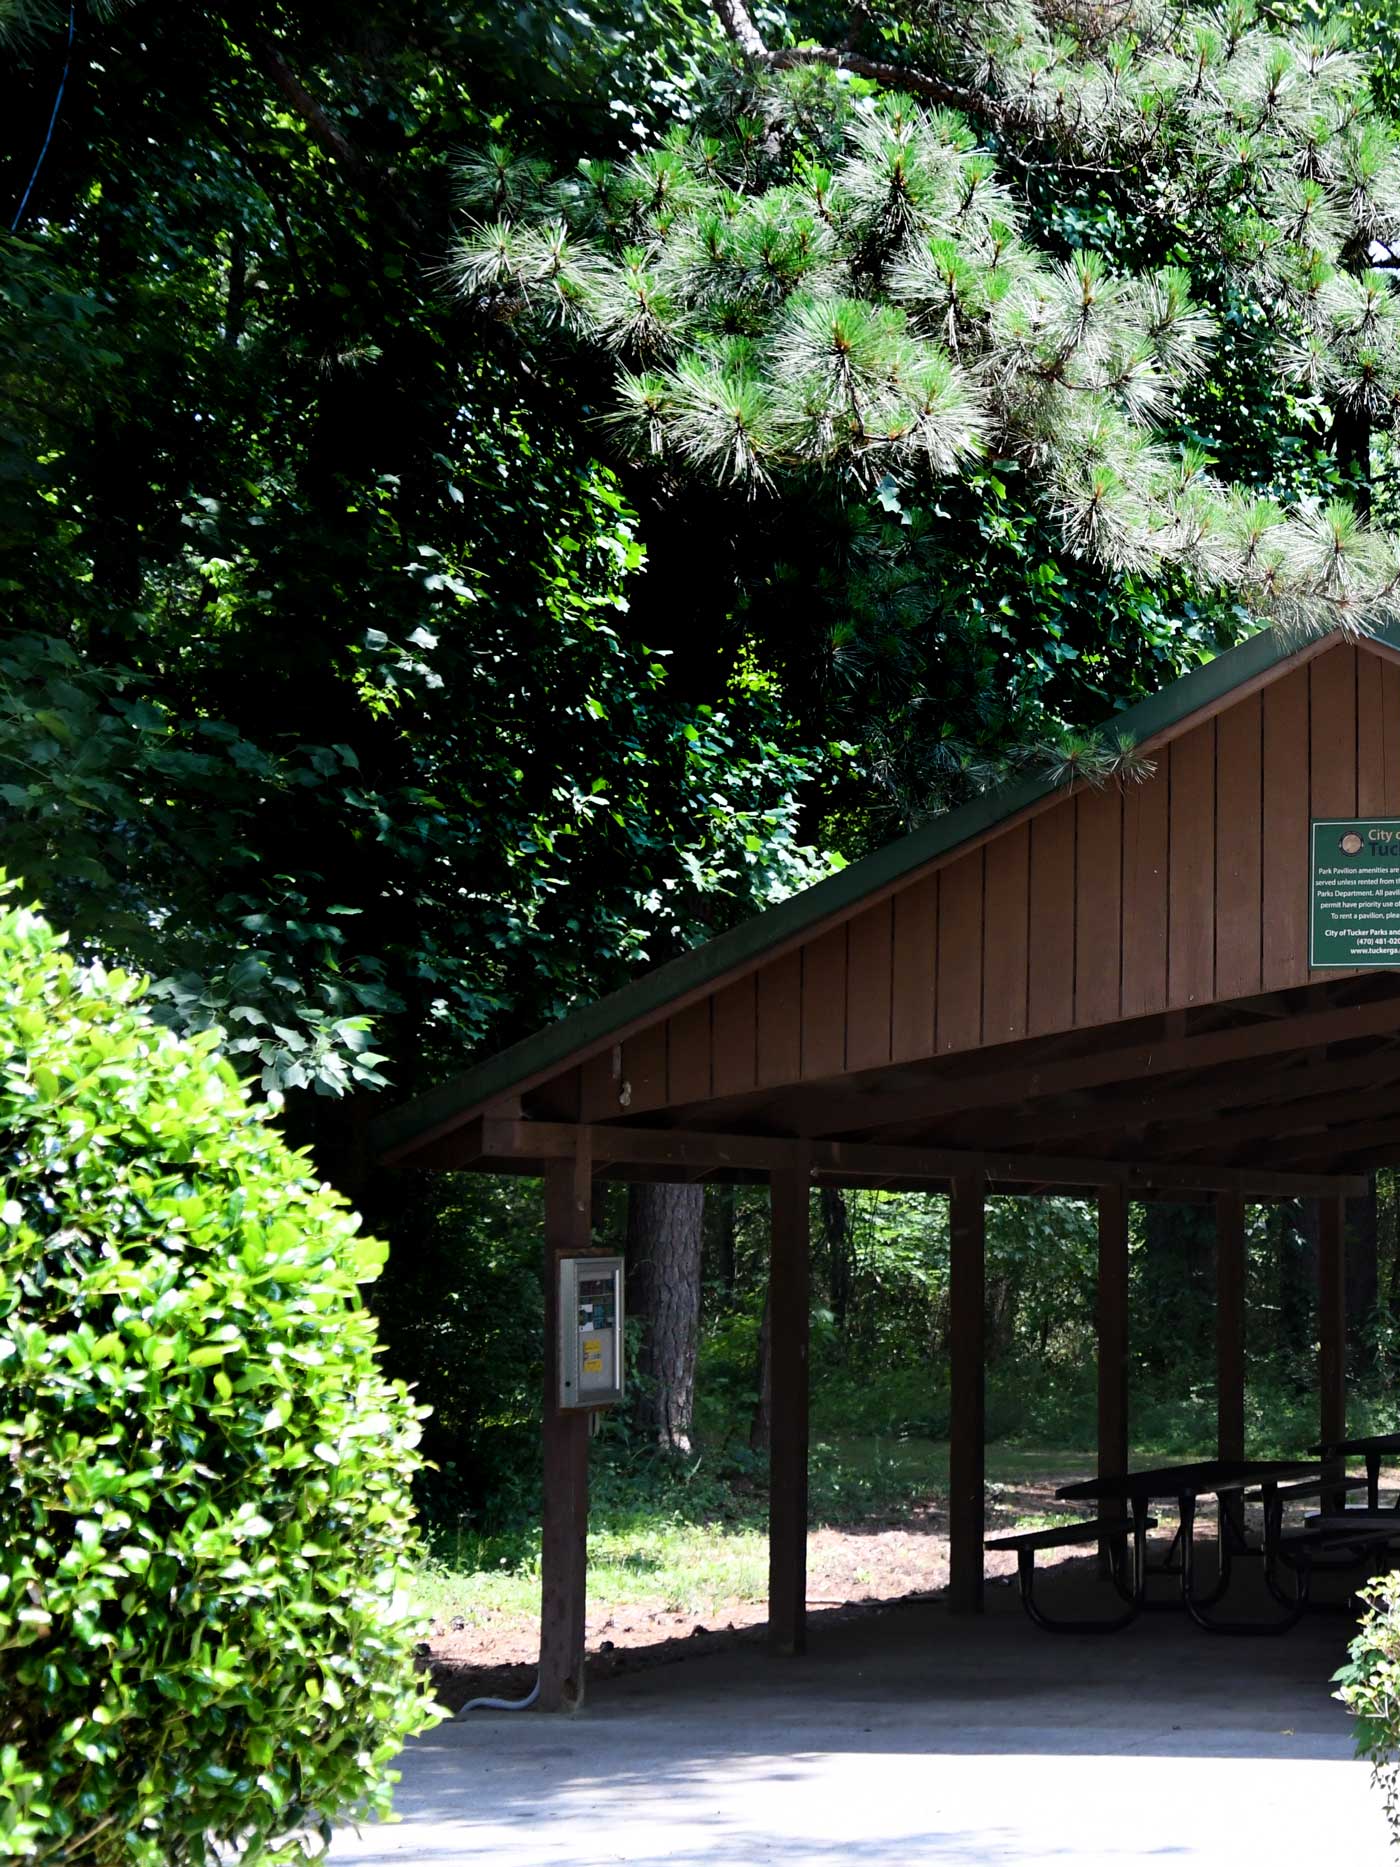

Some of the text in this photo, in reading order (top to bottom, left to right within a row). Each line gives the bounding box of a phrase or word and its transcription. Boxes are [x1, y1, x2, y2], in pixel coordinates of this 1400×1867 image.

[1369, 829, 1392, 842] City
[1335, 890, 1373, 898] Department.
[1325, 929, 1338, 937] City
